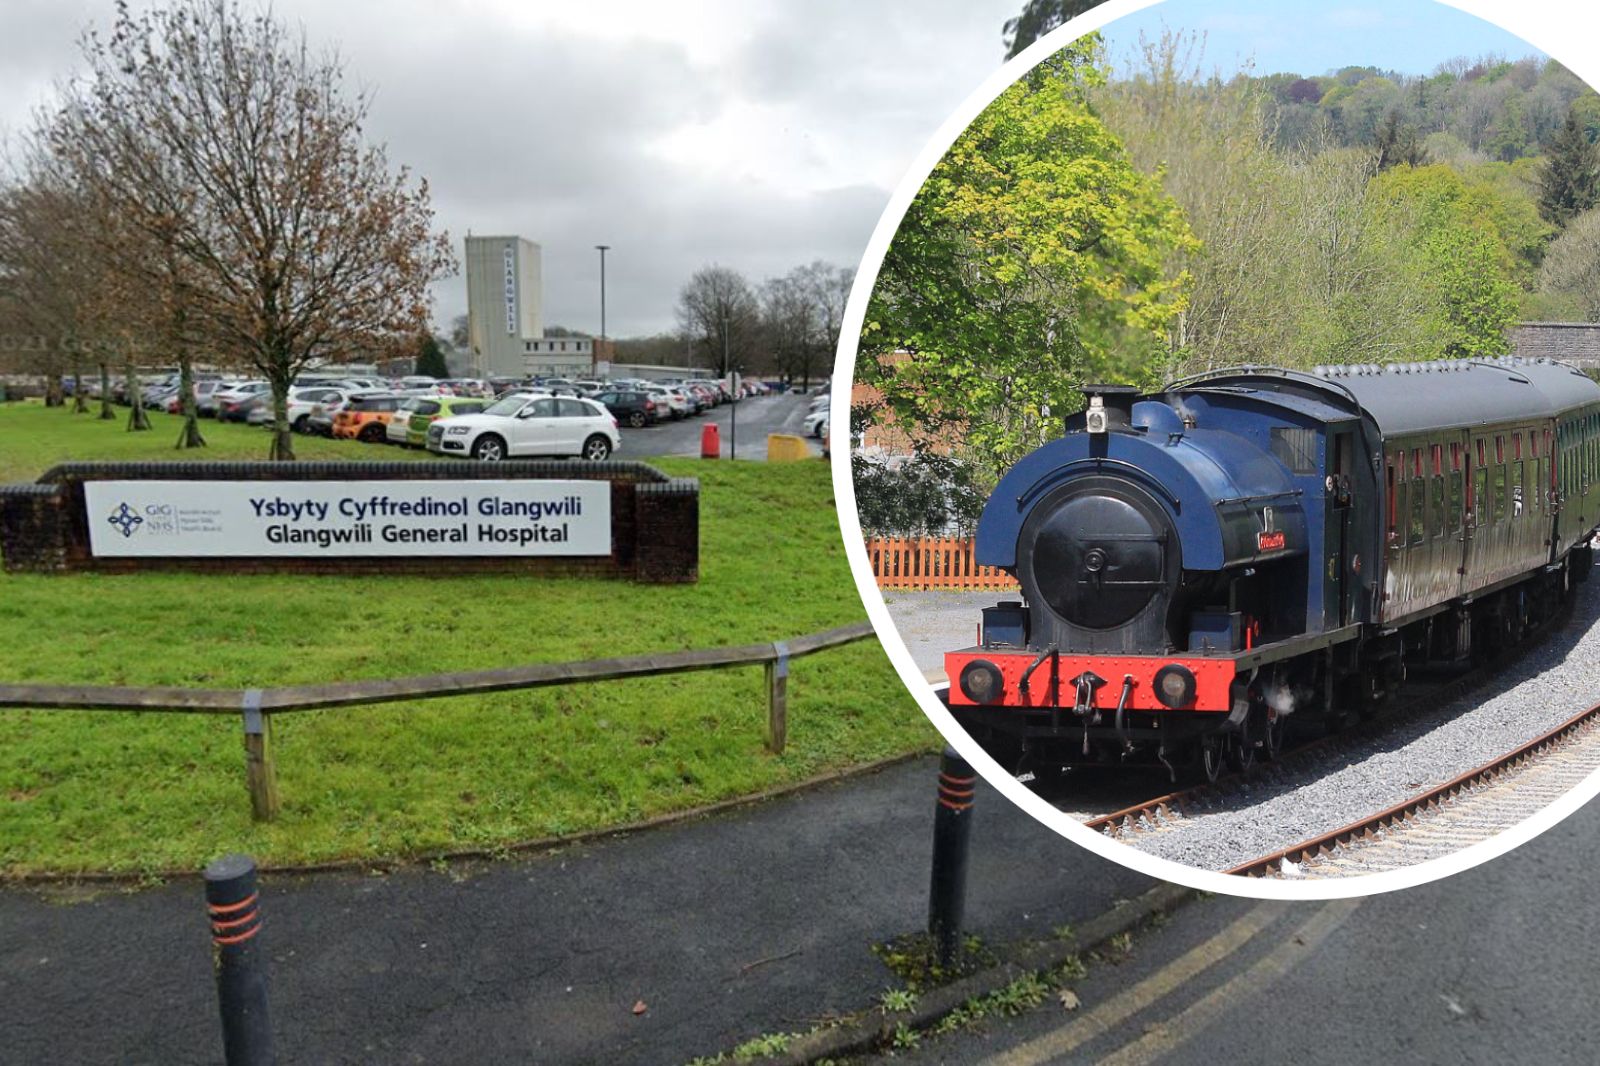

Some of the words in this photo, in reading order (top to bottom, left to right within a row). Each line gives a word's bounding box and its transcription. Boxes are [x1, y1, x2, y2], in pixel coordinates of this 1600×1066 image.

[145, 504, 172, 516] GIG
[249, 496, 329, 522] Ysbyty
[338, 496, 469, 521] Cyffredinol
[477, 496, 582, 521] Glangwili
[147, 521, 174, 532] NHS
[265, 523, 373, 548] Glangwili
[381, 523, 469, 543] General
[477, 523, 569, 547] Hospital
